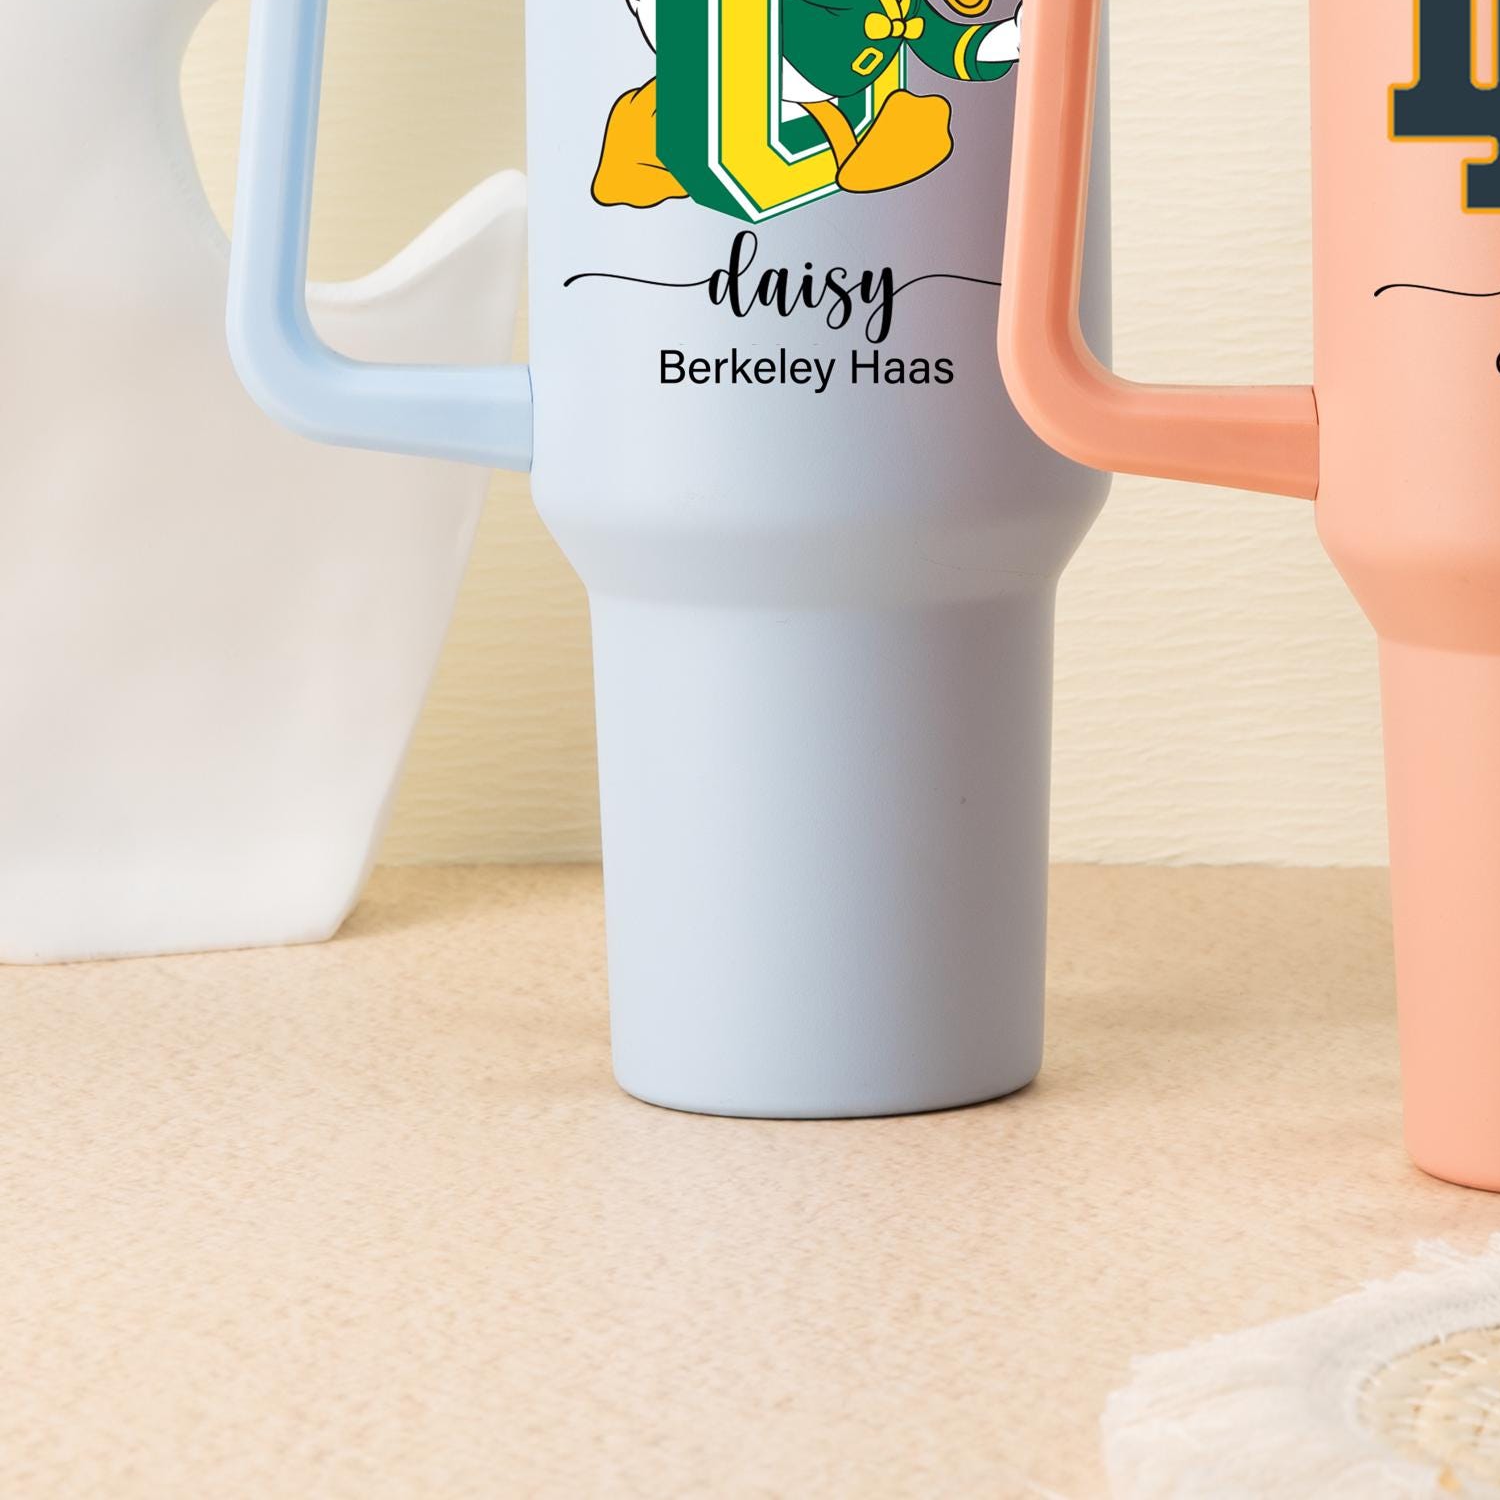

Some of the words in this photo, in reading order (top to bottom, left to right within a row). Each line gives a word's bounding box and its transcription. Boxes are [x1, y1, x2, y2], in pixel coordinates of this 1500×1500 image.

[708, 230, 894, 344] daisy
[660, 347, 836, 394] Berkeley
[851, 349, 954, 385] Haas
